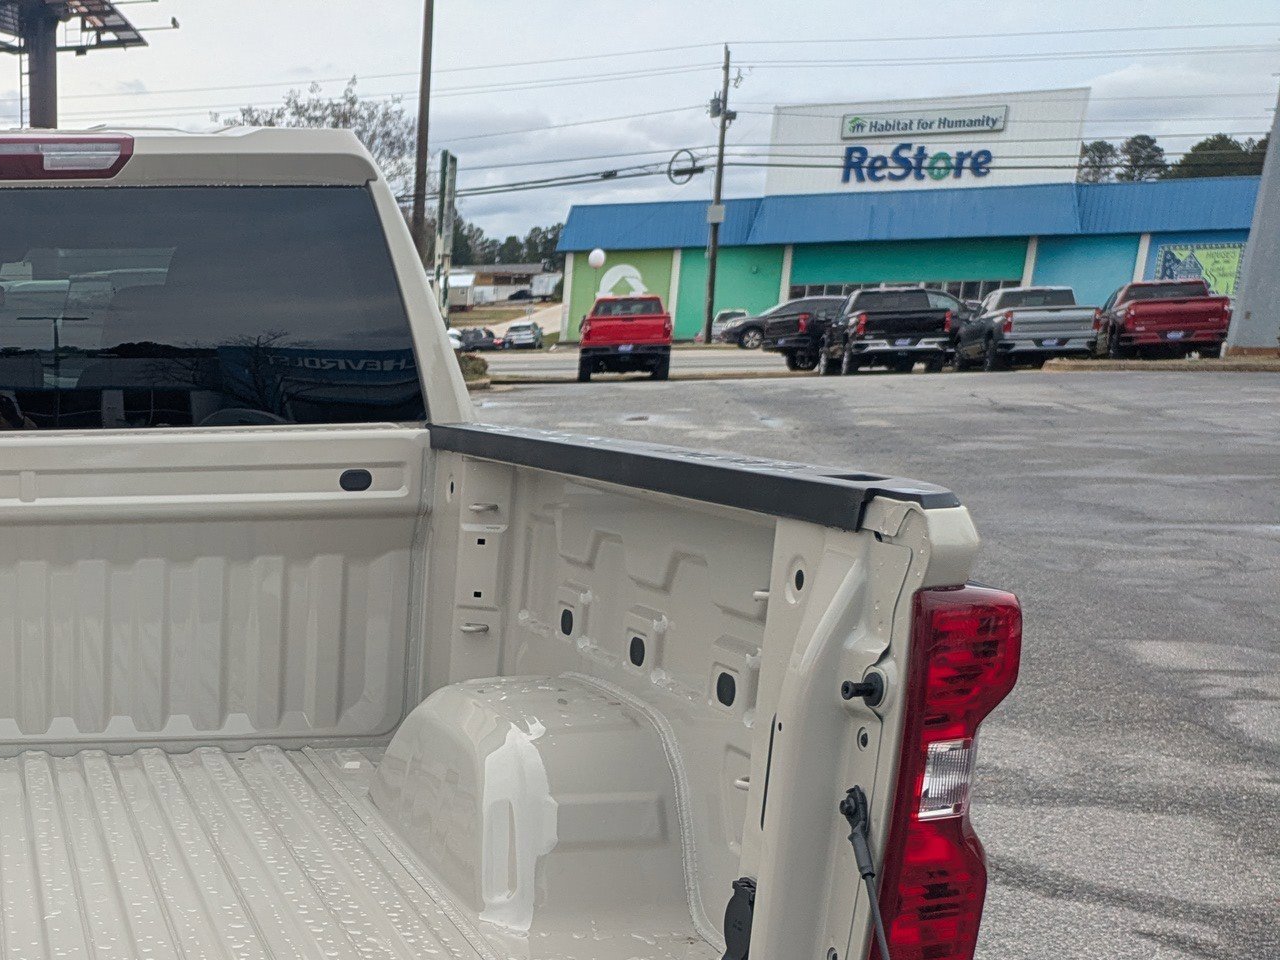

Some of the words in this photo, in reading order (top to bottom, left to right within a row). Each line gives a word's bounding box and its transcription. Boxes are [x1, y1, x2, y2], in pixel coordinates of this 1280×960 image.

[869, 120, 913, 133] Habitat
[917, 118, 934, 131] for
[937, 115, 998, 129] Humanity
[841, 143, 993, 184] ReStore
